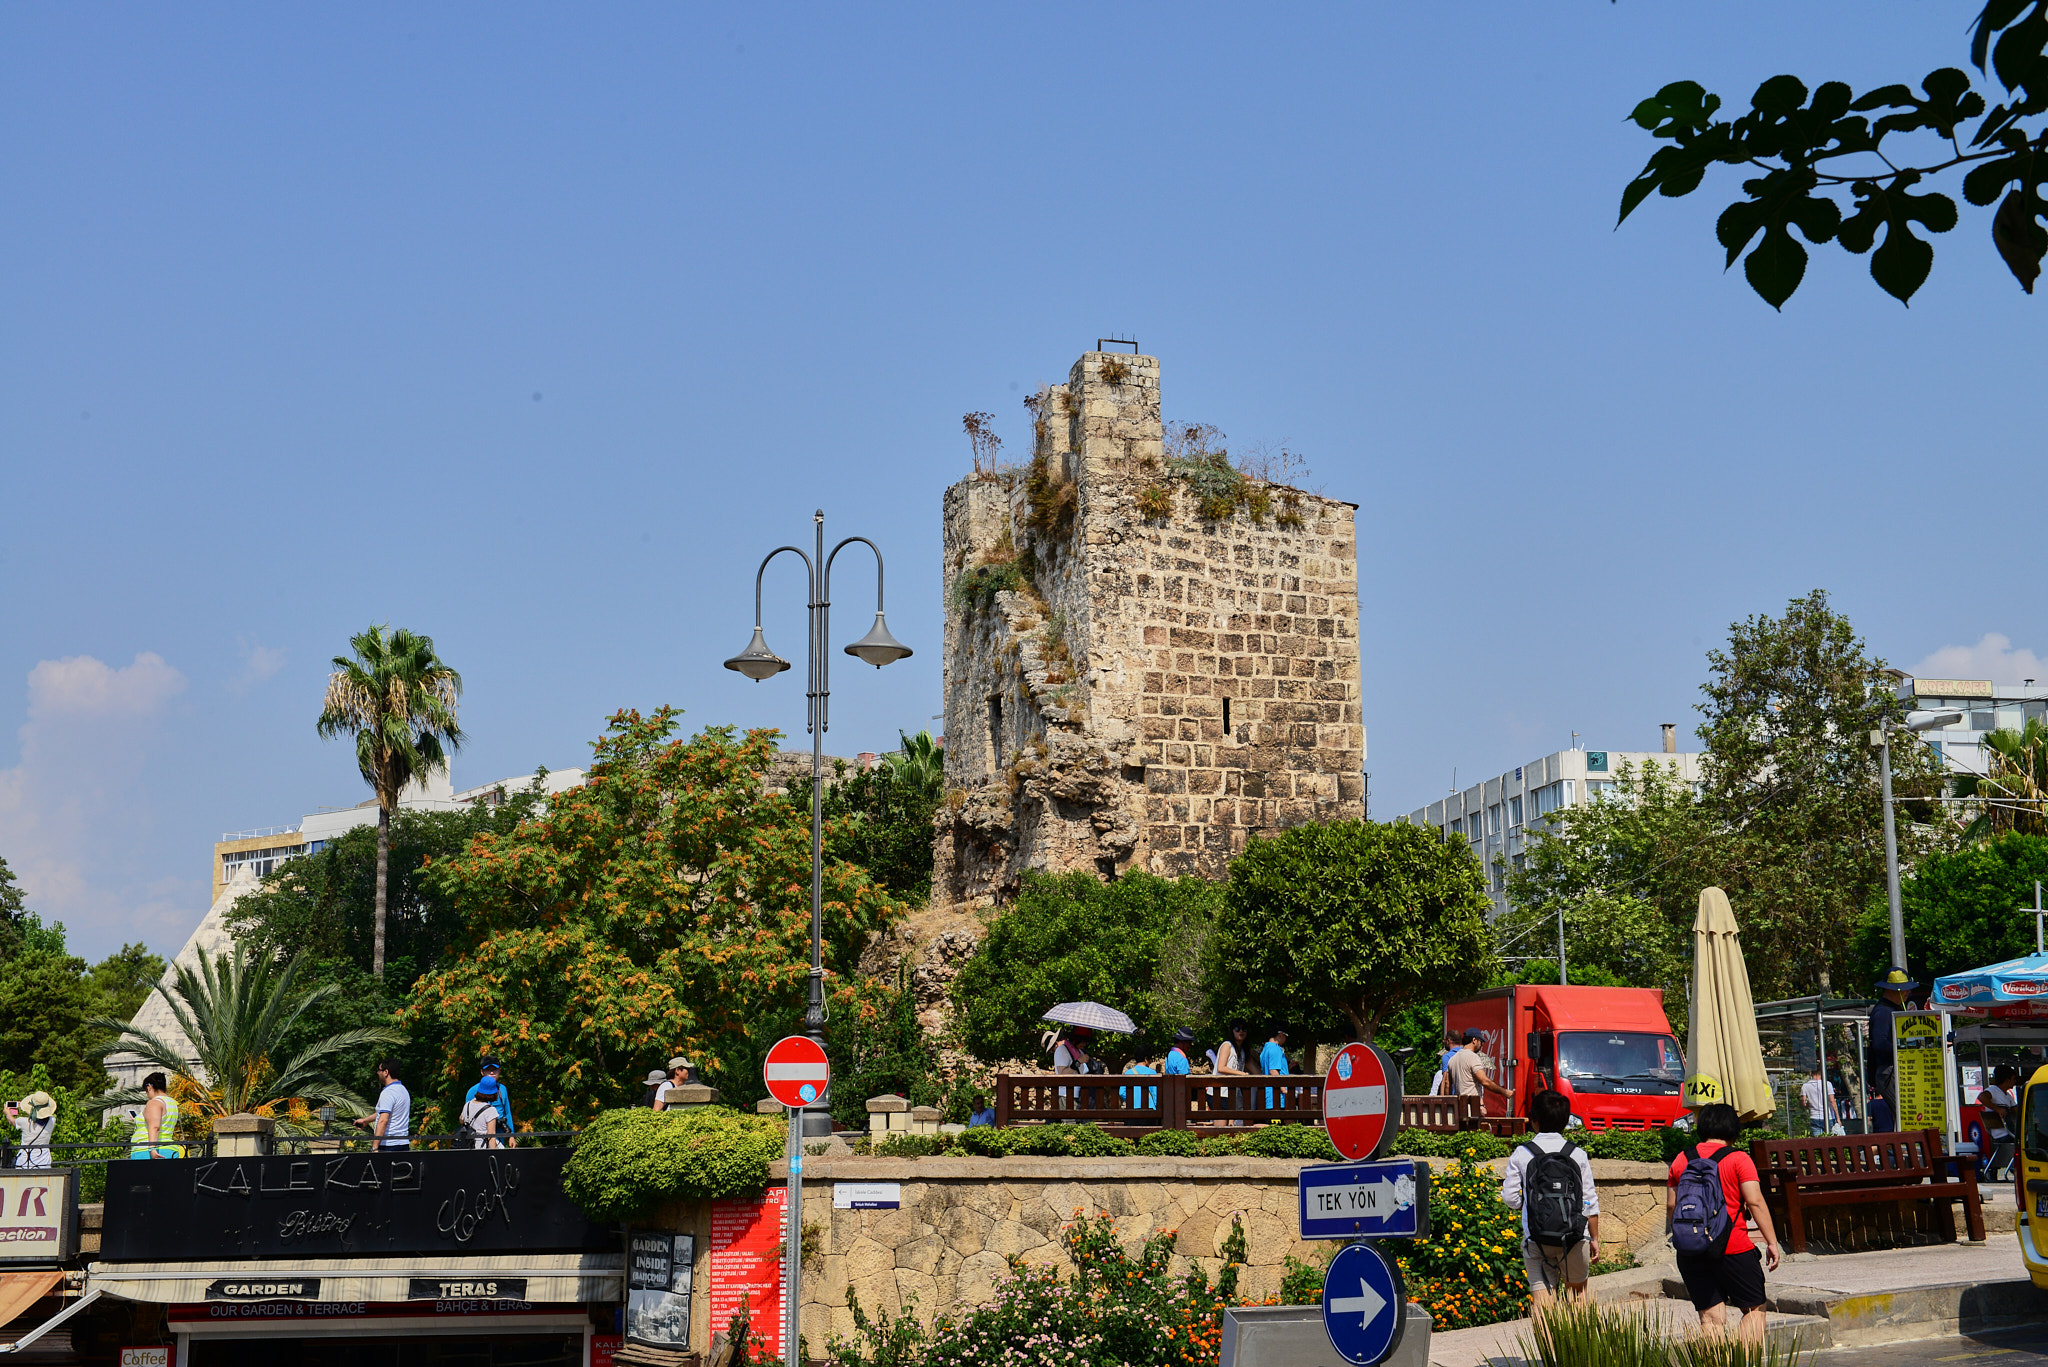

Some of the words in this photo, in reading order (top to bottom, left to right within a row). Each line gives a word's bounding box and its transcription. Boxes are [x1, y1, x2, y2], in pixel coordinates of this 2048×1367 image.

[1957, 681, 1986, 694] CAFE
[1317, 1193, 1343, 1212] TEK
[1347, 1186, 1377, 1209] YÖN
[632, 1239, 669, 1253] GARDEN
[636, 1256, 667, 1271] INSIDE
[223, 1284, 303, 1296] GARDEN
[439, 1282, 498, 1298] TERAS
[210, 1305, 238, 1317] OUR
[240, 1304, 293, 1316] GARDEN
[295, 1304, 305, 1315] &
[306, 1302, 366, 1315] TERRACE
[436, 1300, 478, 1314] BAHÇE
[480, 1300, 490, 1312] &
[491, 1300, 532, 1311] TERAS
[122, 1353, 167, 1366] Coffee
